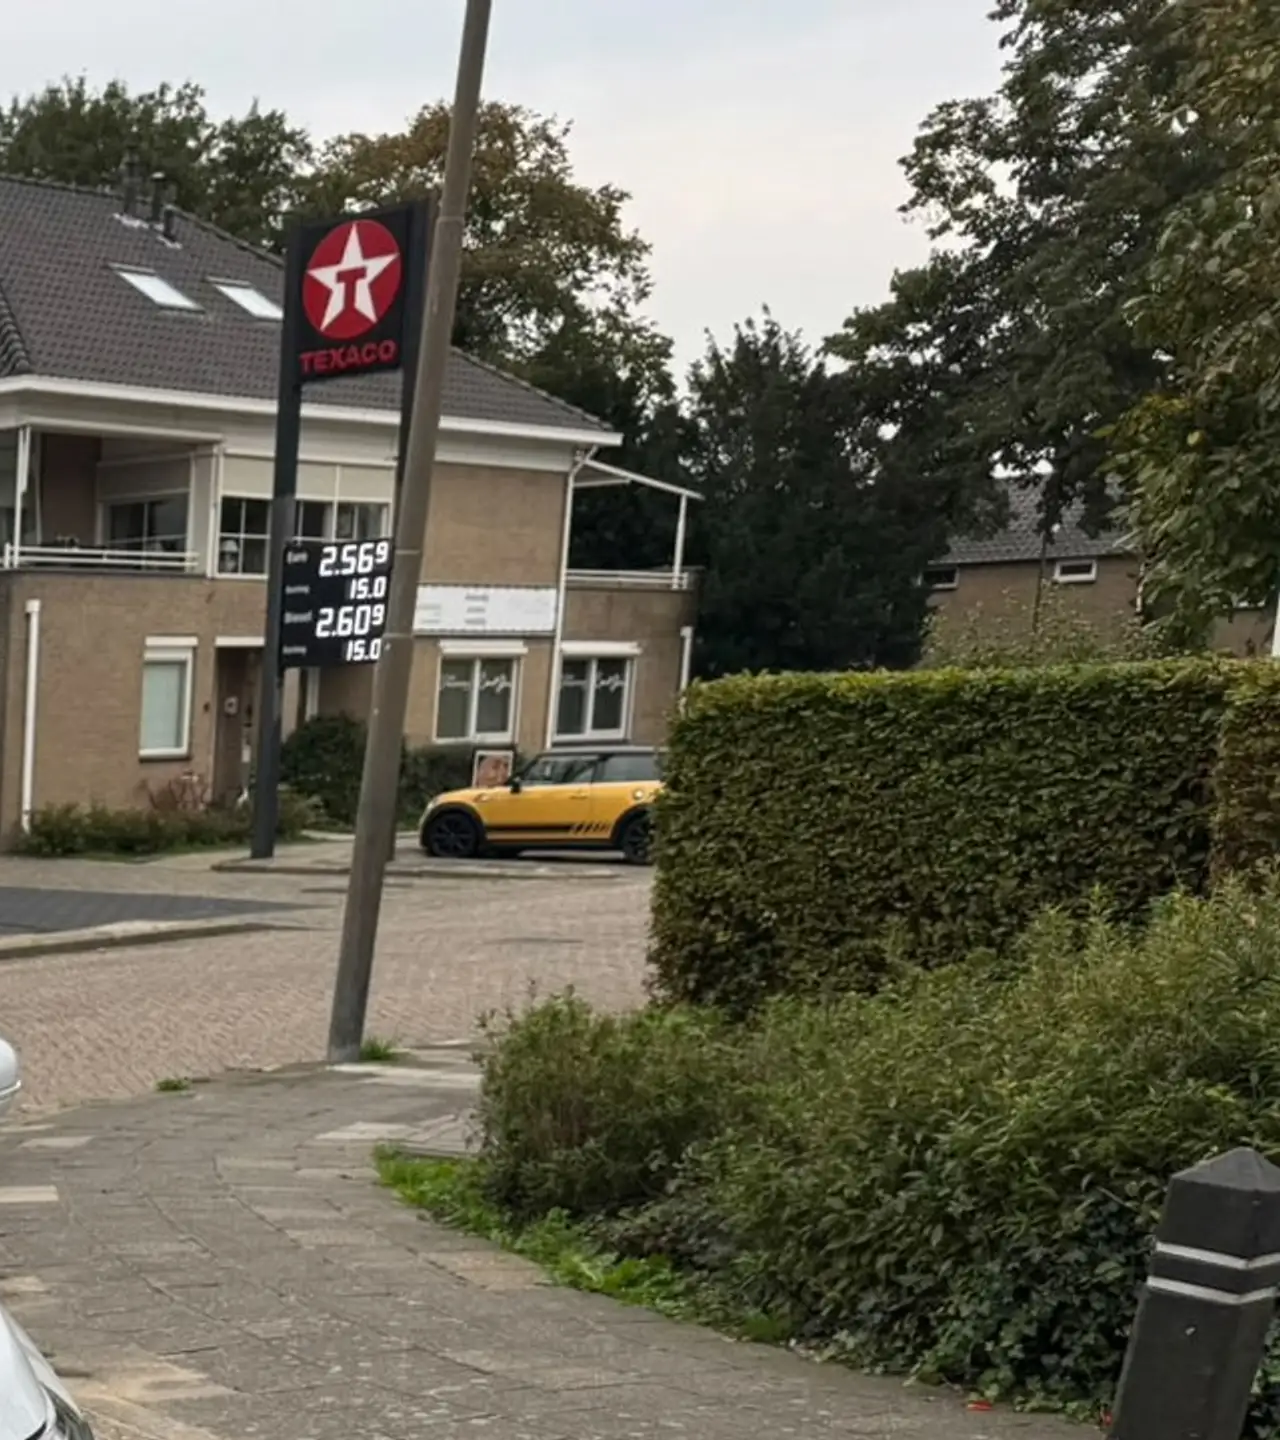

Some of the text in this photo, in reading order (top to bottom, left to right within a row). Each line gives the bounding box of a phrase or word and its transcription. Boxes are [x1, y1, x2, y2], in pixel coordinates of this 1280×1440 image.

[299, 339, 397, 374] TEXACO
[318, 541, 389, 577] 2.569
[349, 576, 387, 600] 15.0
[315, 603, 385, 638] 2.609
[346, 638, 381, 661] 15.0
